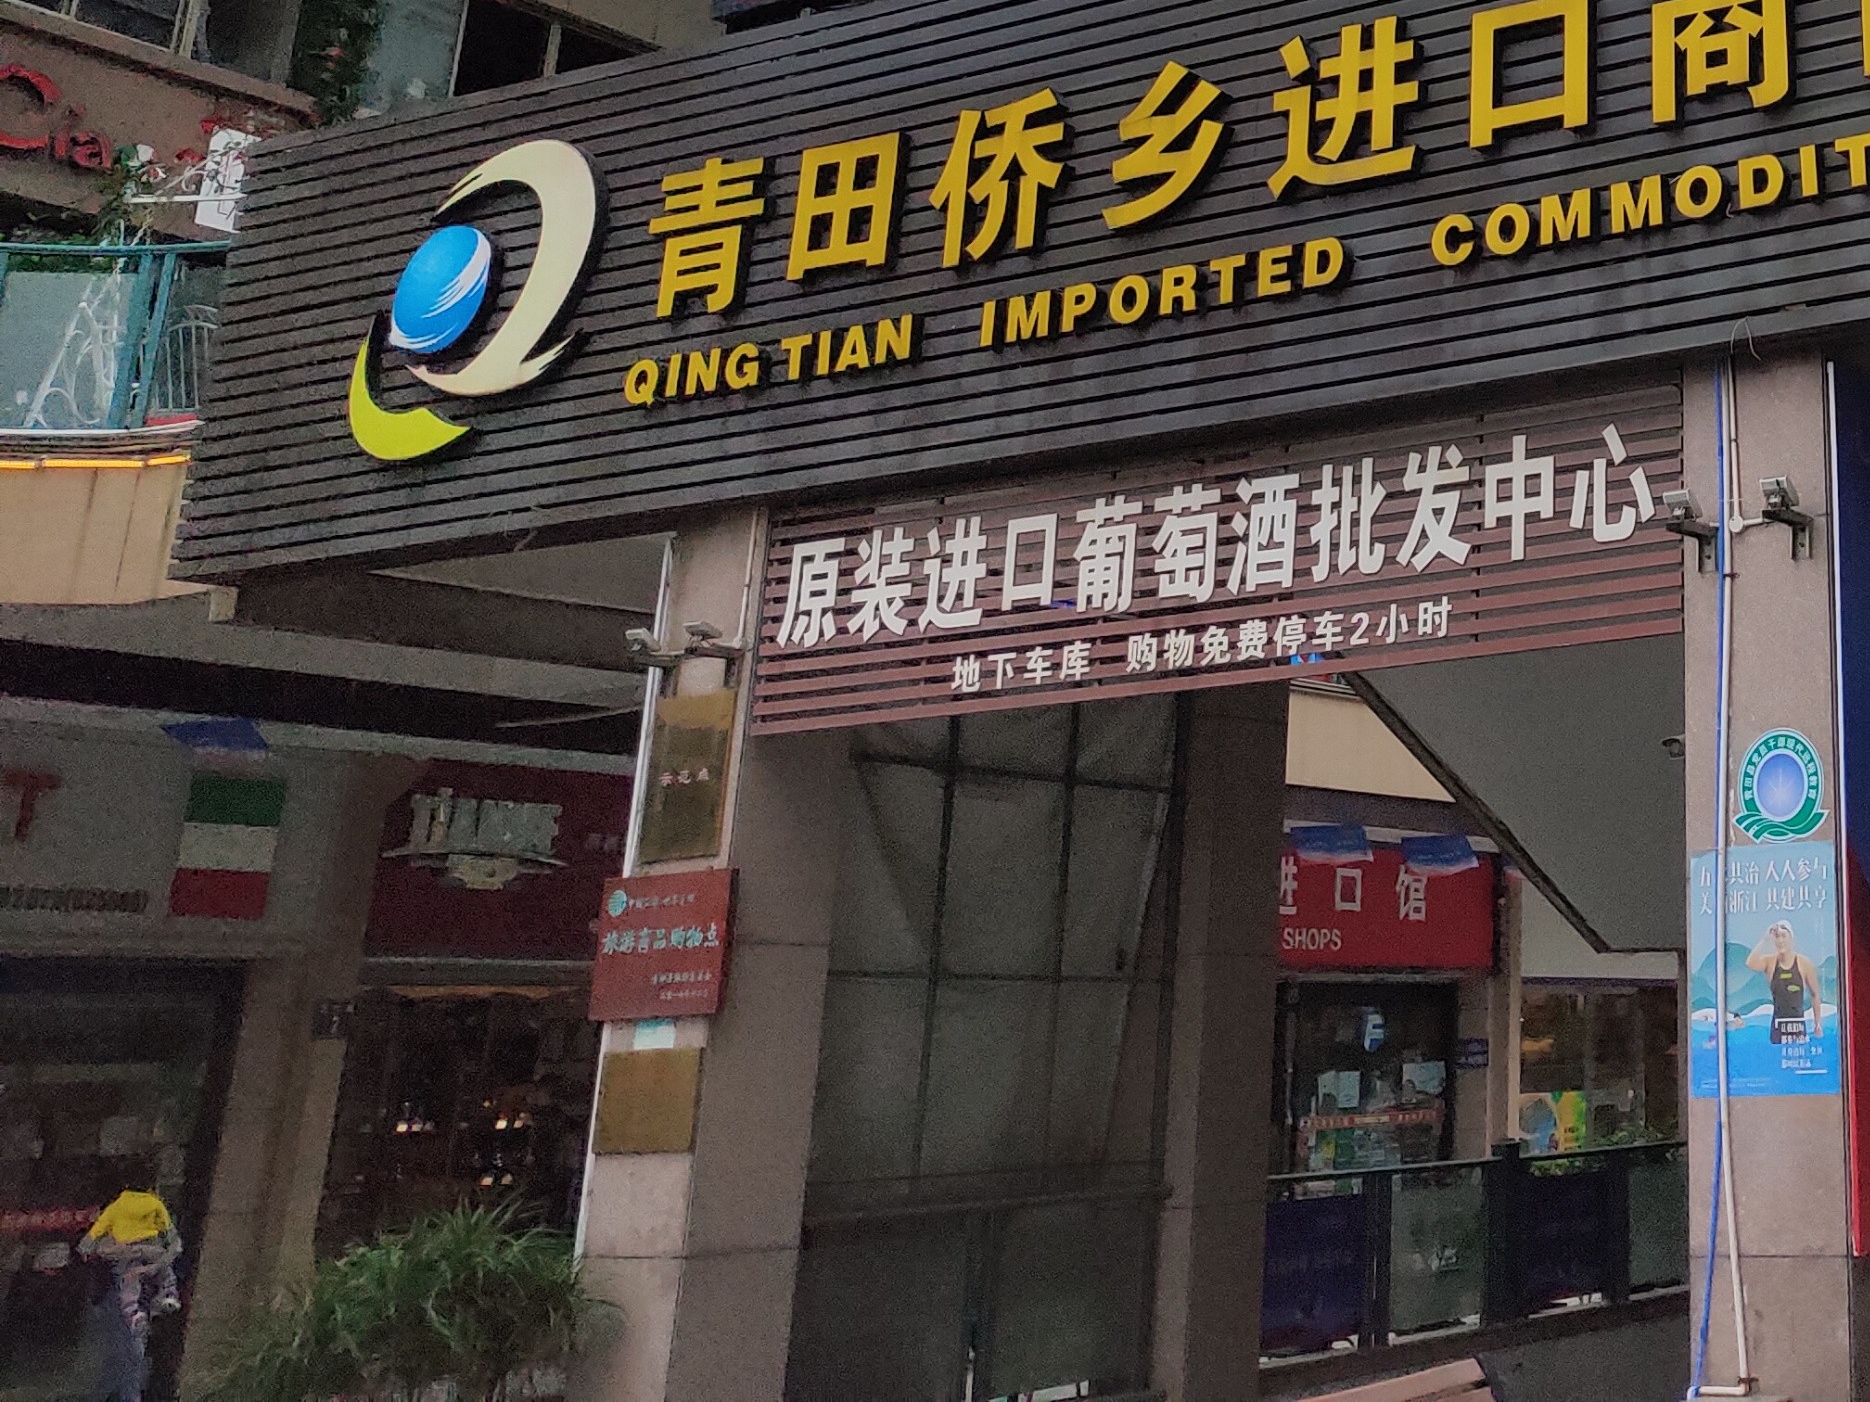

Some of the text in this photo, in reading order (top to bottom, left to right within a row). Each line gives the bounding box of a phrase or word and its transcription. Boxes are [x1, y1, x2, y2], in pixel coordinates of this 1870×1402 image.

[980, 236, 1346, 348] IMPORTED
[776, 423, 1660, 650] 原装进口葡萄酒批发中心
[951, 597, 1455, 697] 地下车库 购物免费停车2小时
[1282, 927, 1342, 952] SHOPS
[1699, 890, 1758, 916] 美浙江
